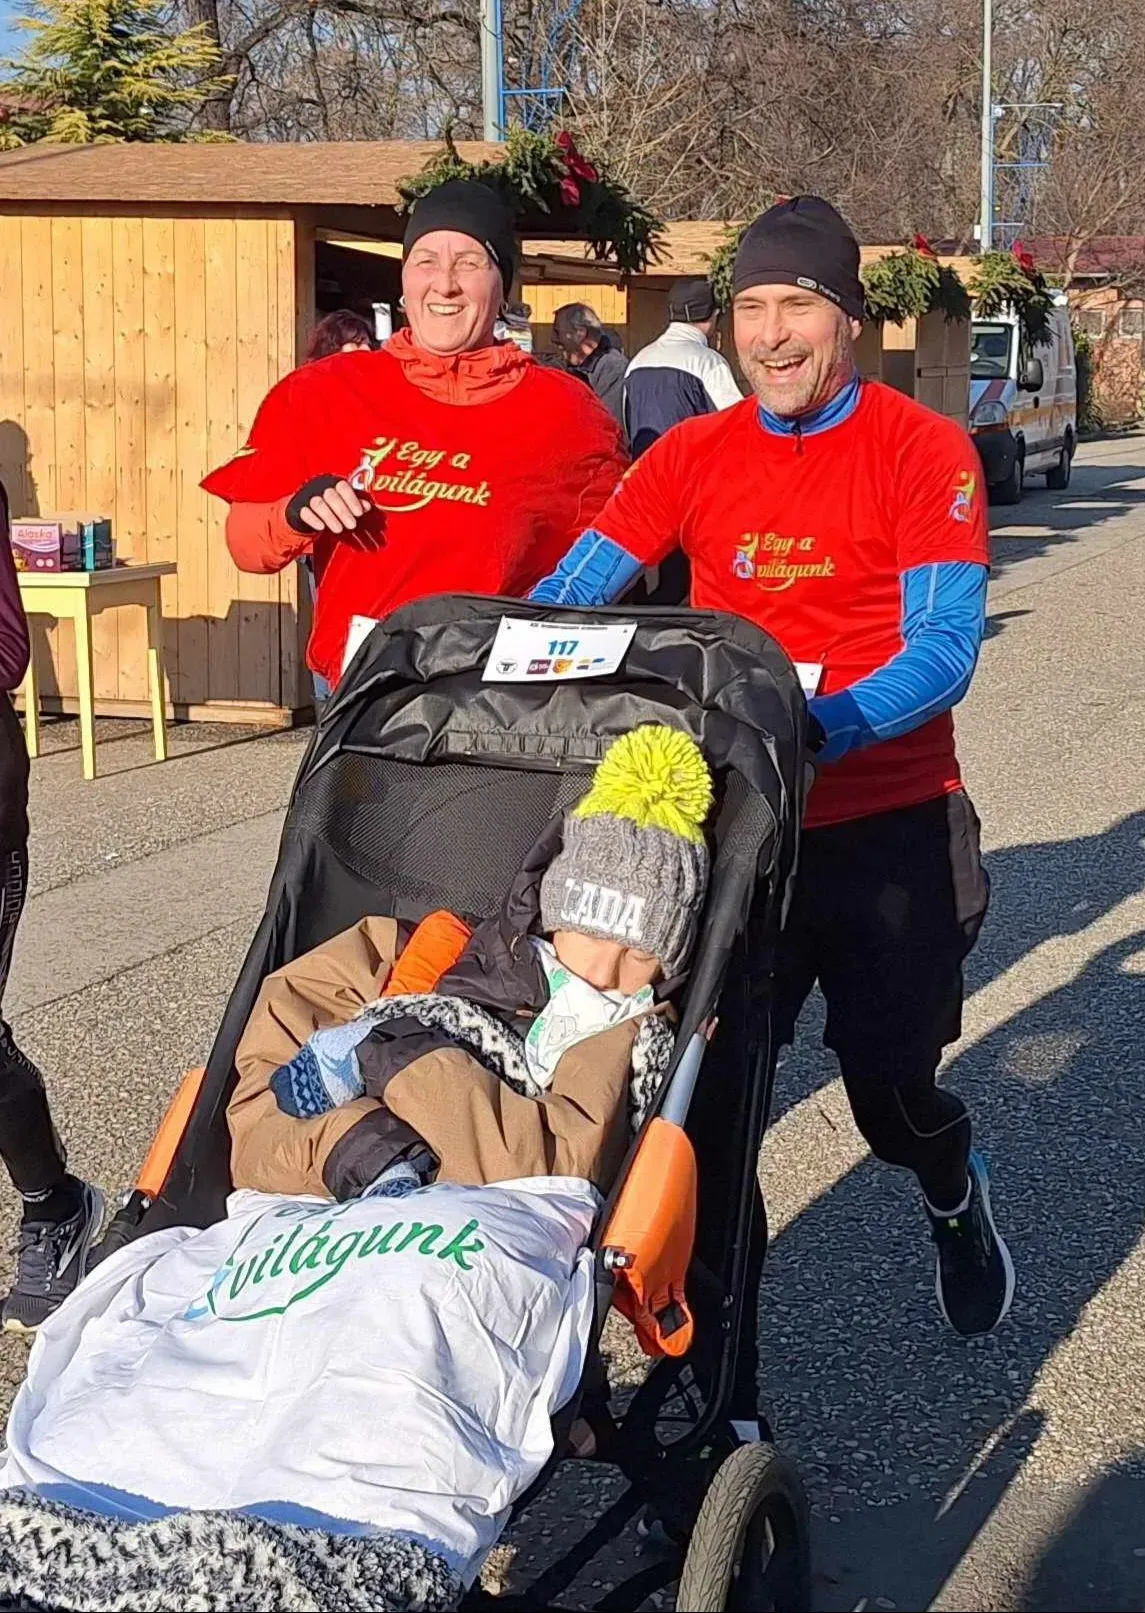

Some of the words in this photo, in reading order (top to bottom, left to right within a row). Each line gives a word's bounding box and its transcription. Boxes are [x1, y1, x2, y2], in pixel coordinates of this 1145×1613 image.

[396, 441, 447, 469] Egy
[451, 452, 471, 469] a
[373, 470, 492, 511] világunk
[761, 532, 795, 556] Egy
[798, 536, 815, 550] a
[756, 556, 835, 591] világunk
[548, 640, 579, 656] 117
[225, 1218, 485, 1312] világunk
